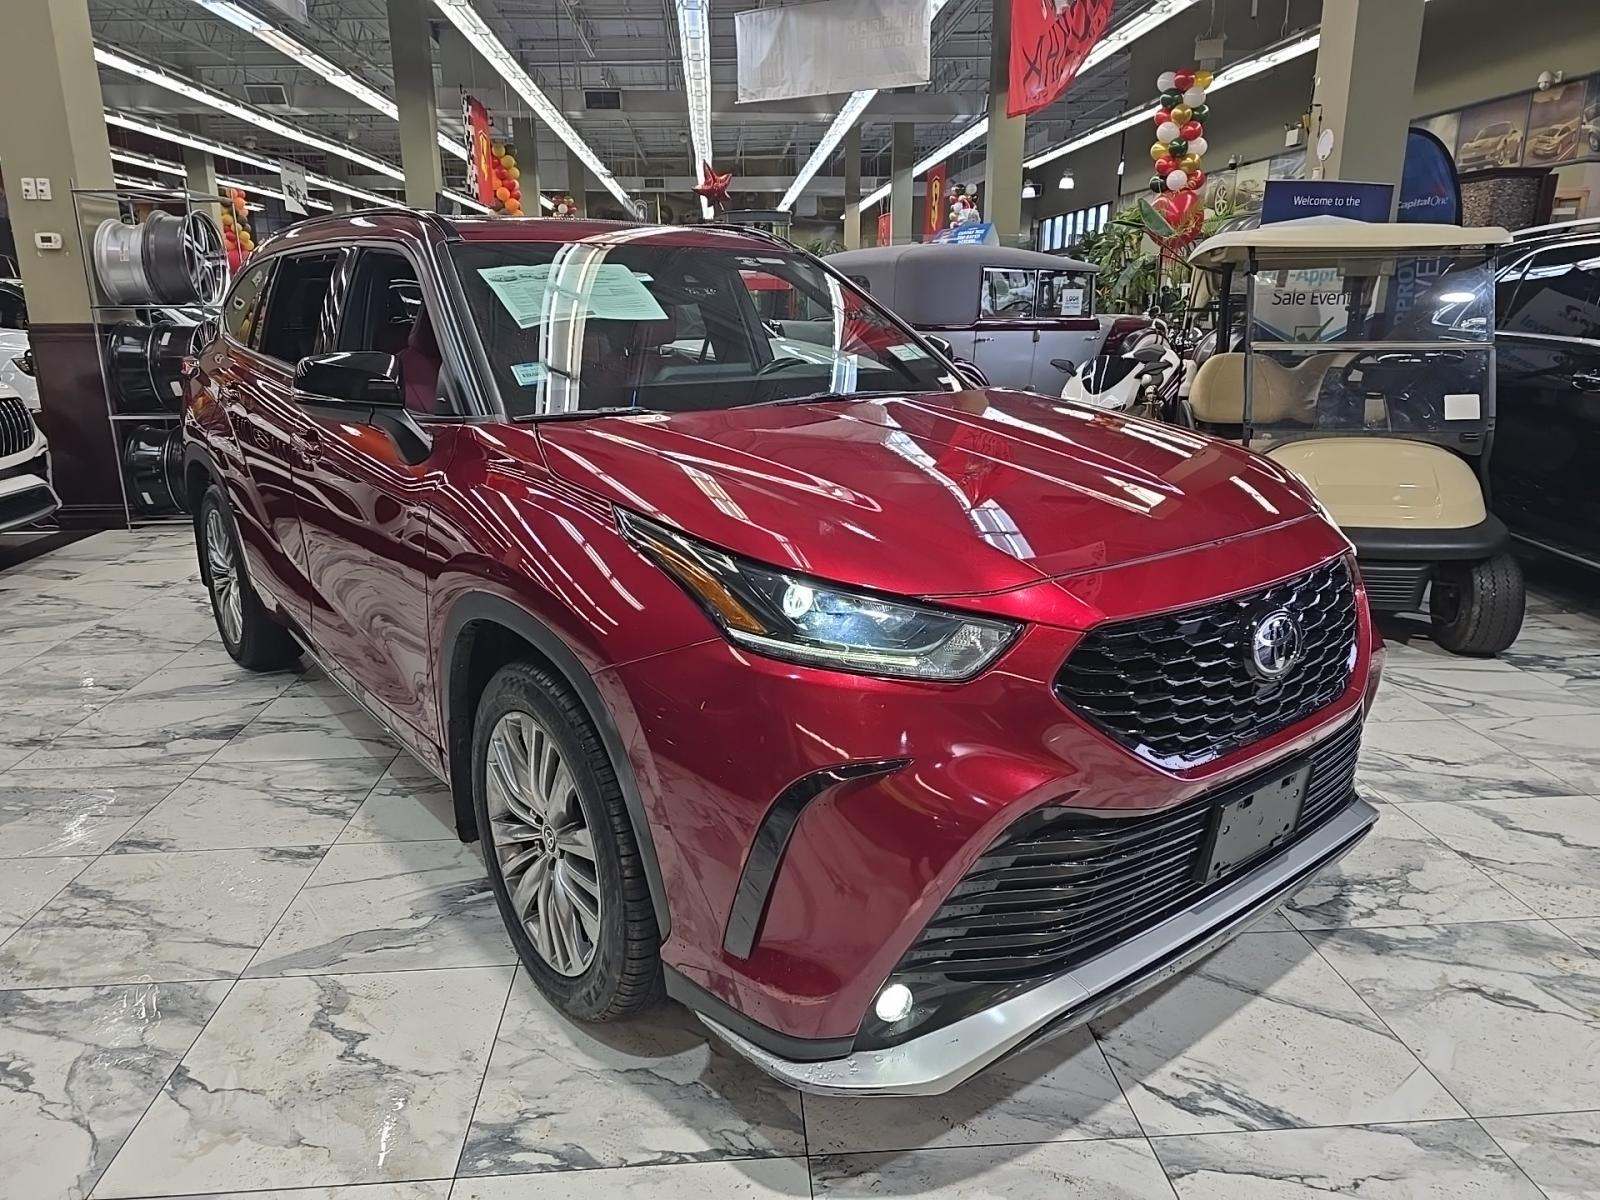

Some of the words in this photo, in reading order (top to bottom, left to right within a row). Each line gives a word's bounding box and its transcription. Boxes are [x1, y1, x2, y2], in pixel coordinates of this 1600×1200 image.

[1293, 195, 1333, 207] Welcome
[1334, 197, 1344, 207] to
[1345, 195, 1361, 207] the
[1271, 289, 1306, 306] Sale
[1309, 289, 1352, 306] Event
